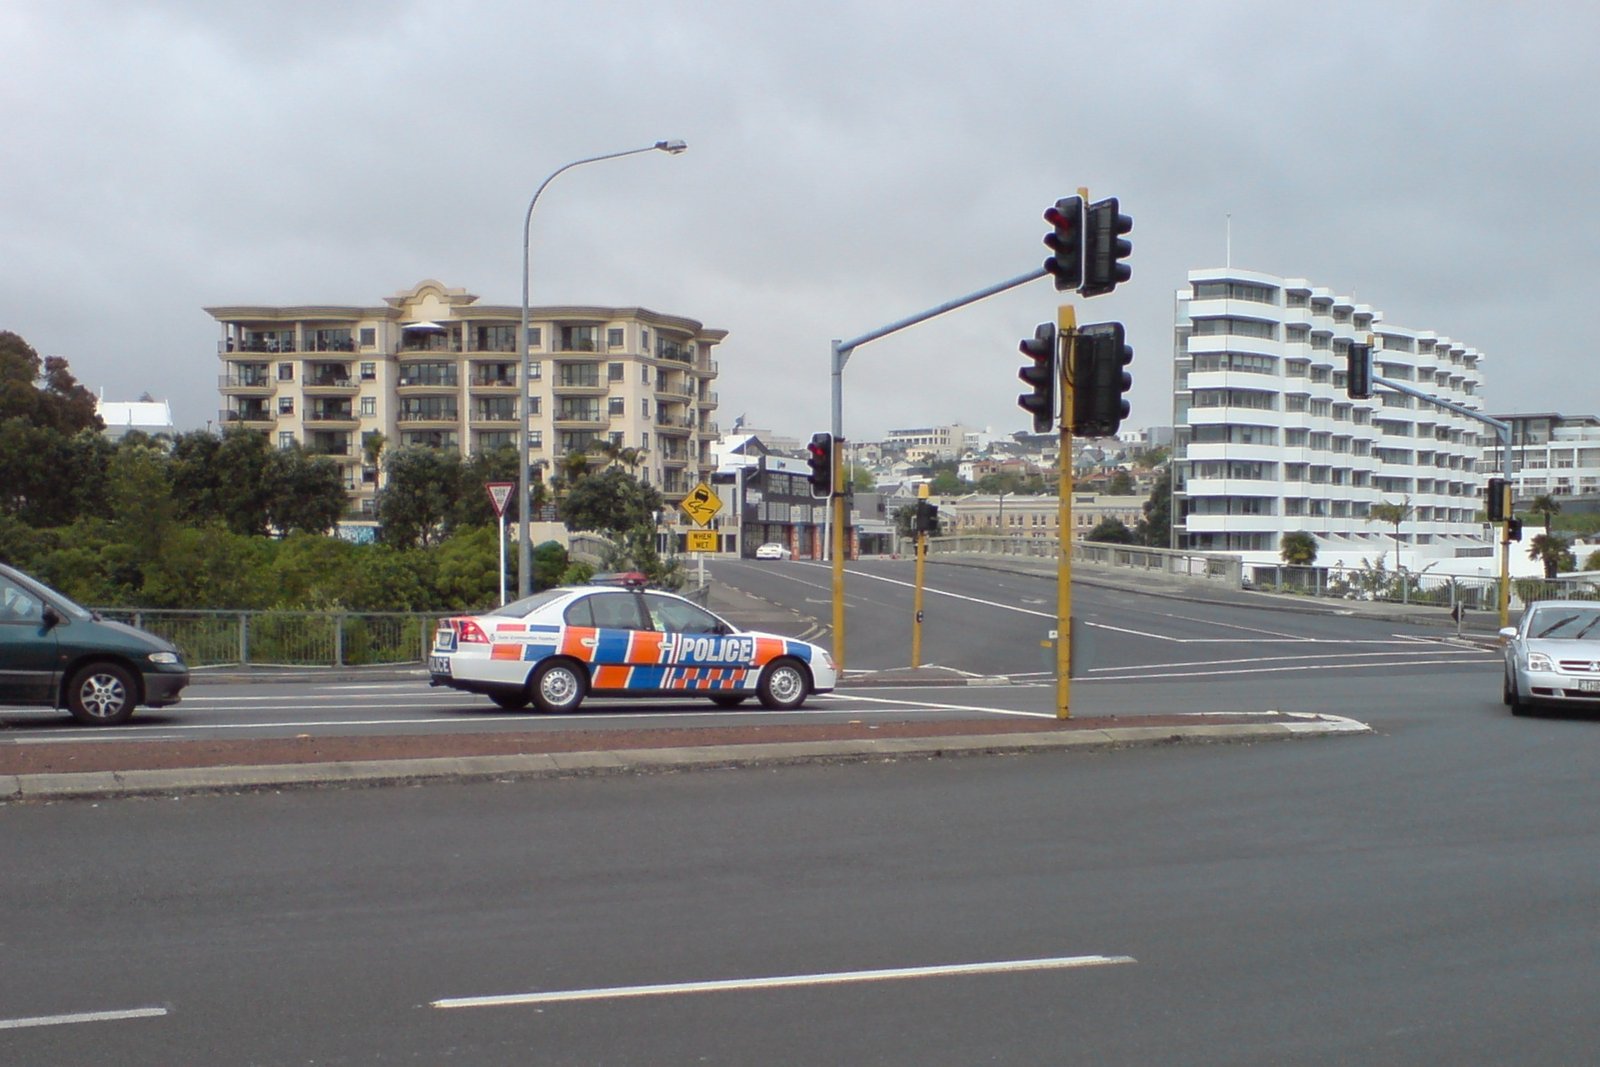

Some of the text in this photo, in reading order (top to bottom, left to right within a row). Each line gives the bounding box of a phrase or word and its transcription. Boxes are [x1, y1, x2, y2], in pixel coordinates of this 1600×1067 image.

[695, 541, 709, 549] WET
[679, 637, 752, 662] POLICE
[428, 656, 449, 672] OLICE
